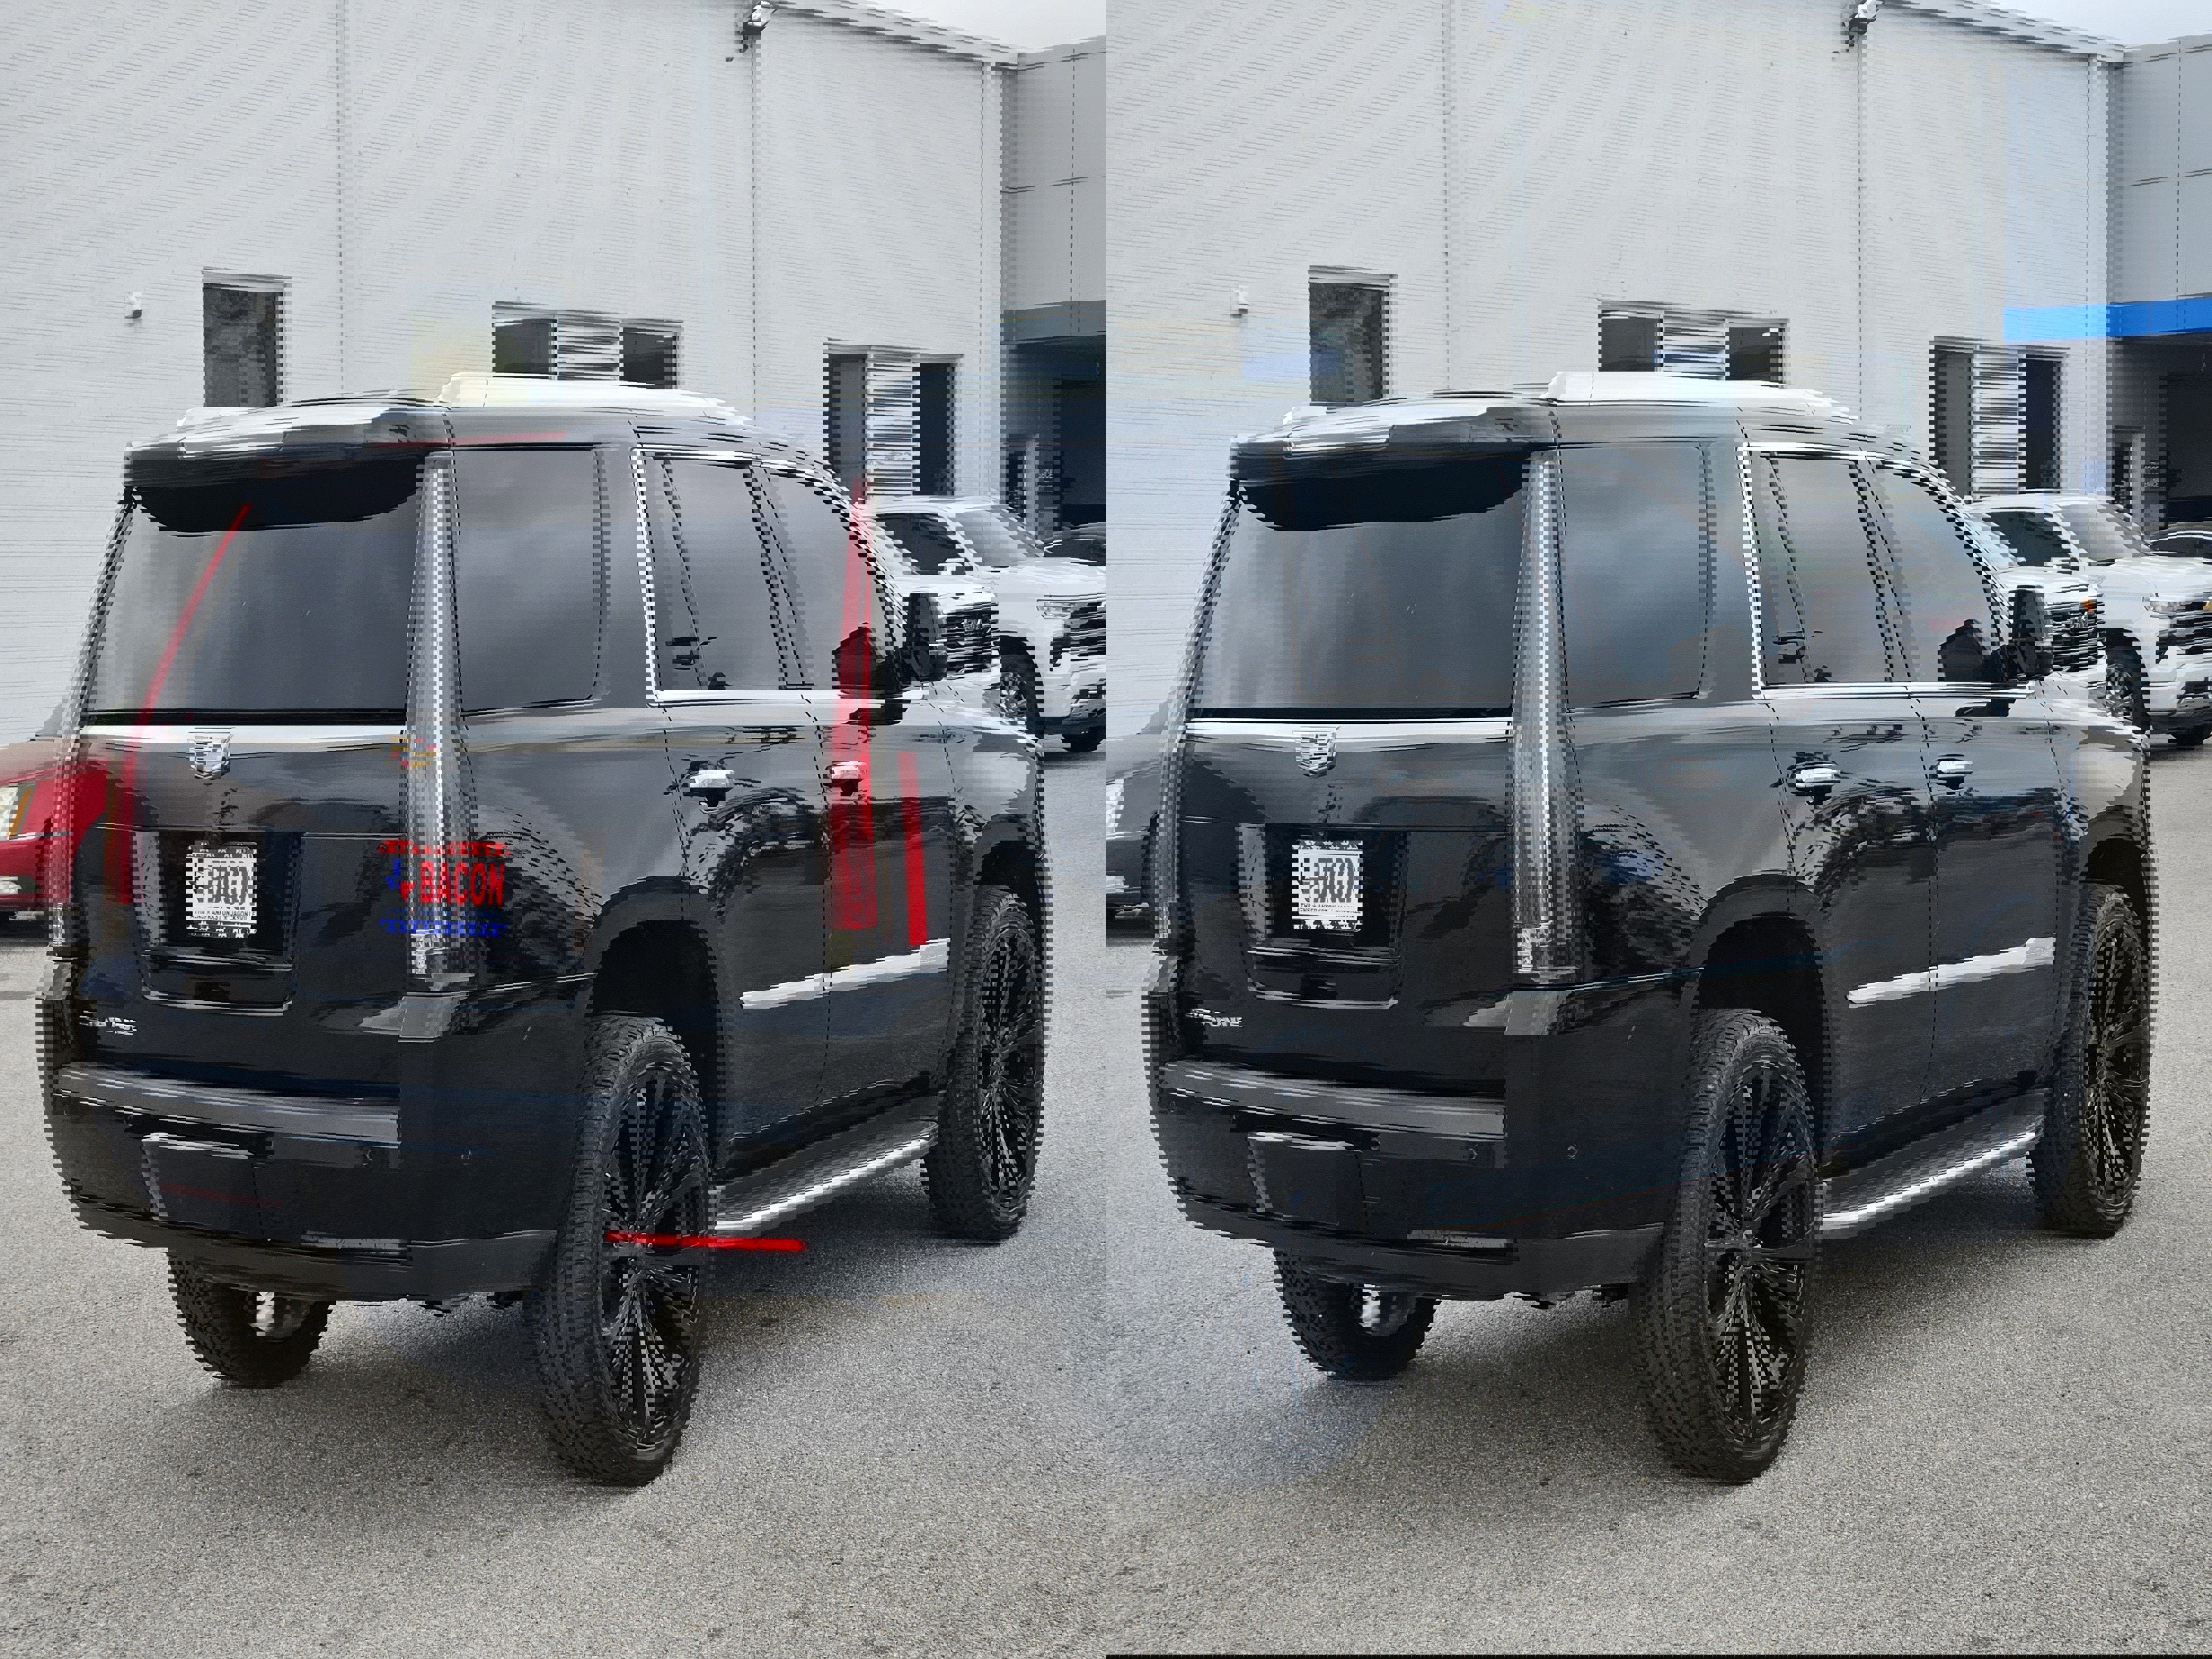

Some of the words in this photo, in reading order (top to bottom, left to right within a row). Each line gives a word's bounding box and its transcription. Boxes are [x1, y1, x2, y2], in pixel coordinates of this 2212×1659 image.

[2082, 466, 2106, 475] SERVICE
[1928, 614, 1972, 632] GMC
[420, 860, 504, 906] BACON
[385, 907, 408, 915] ATHENS
[416, 908, 452, 916] FRANKSTON
[460, 910, 503, 919] JACKSONVILLE
[163, 1010, 270, 1032] ESCALADE
